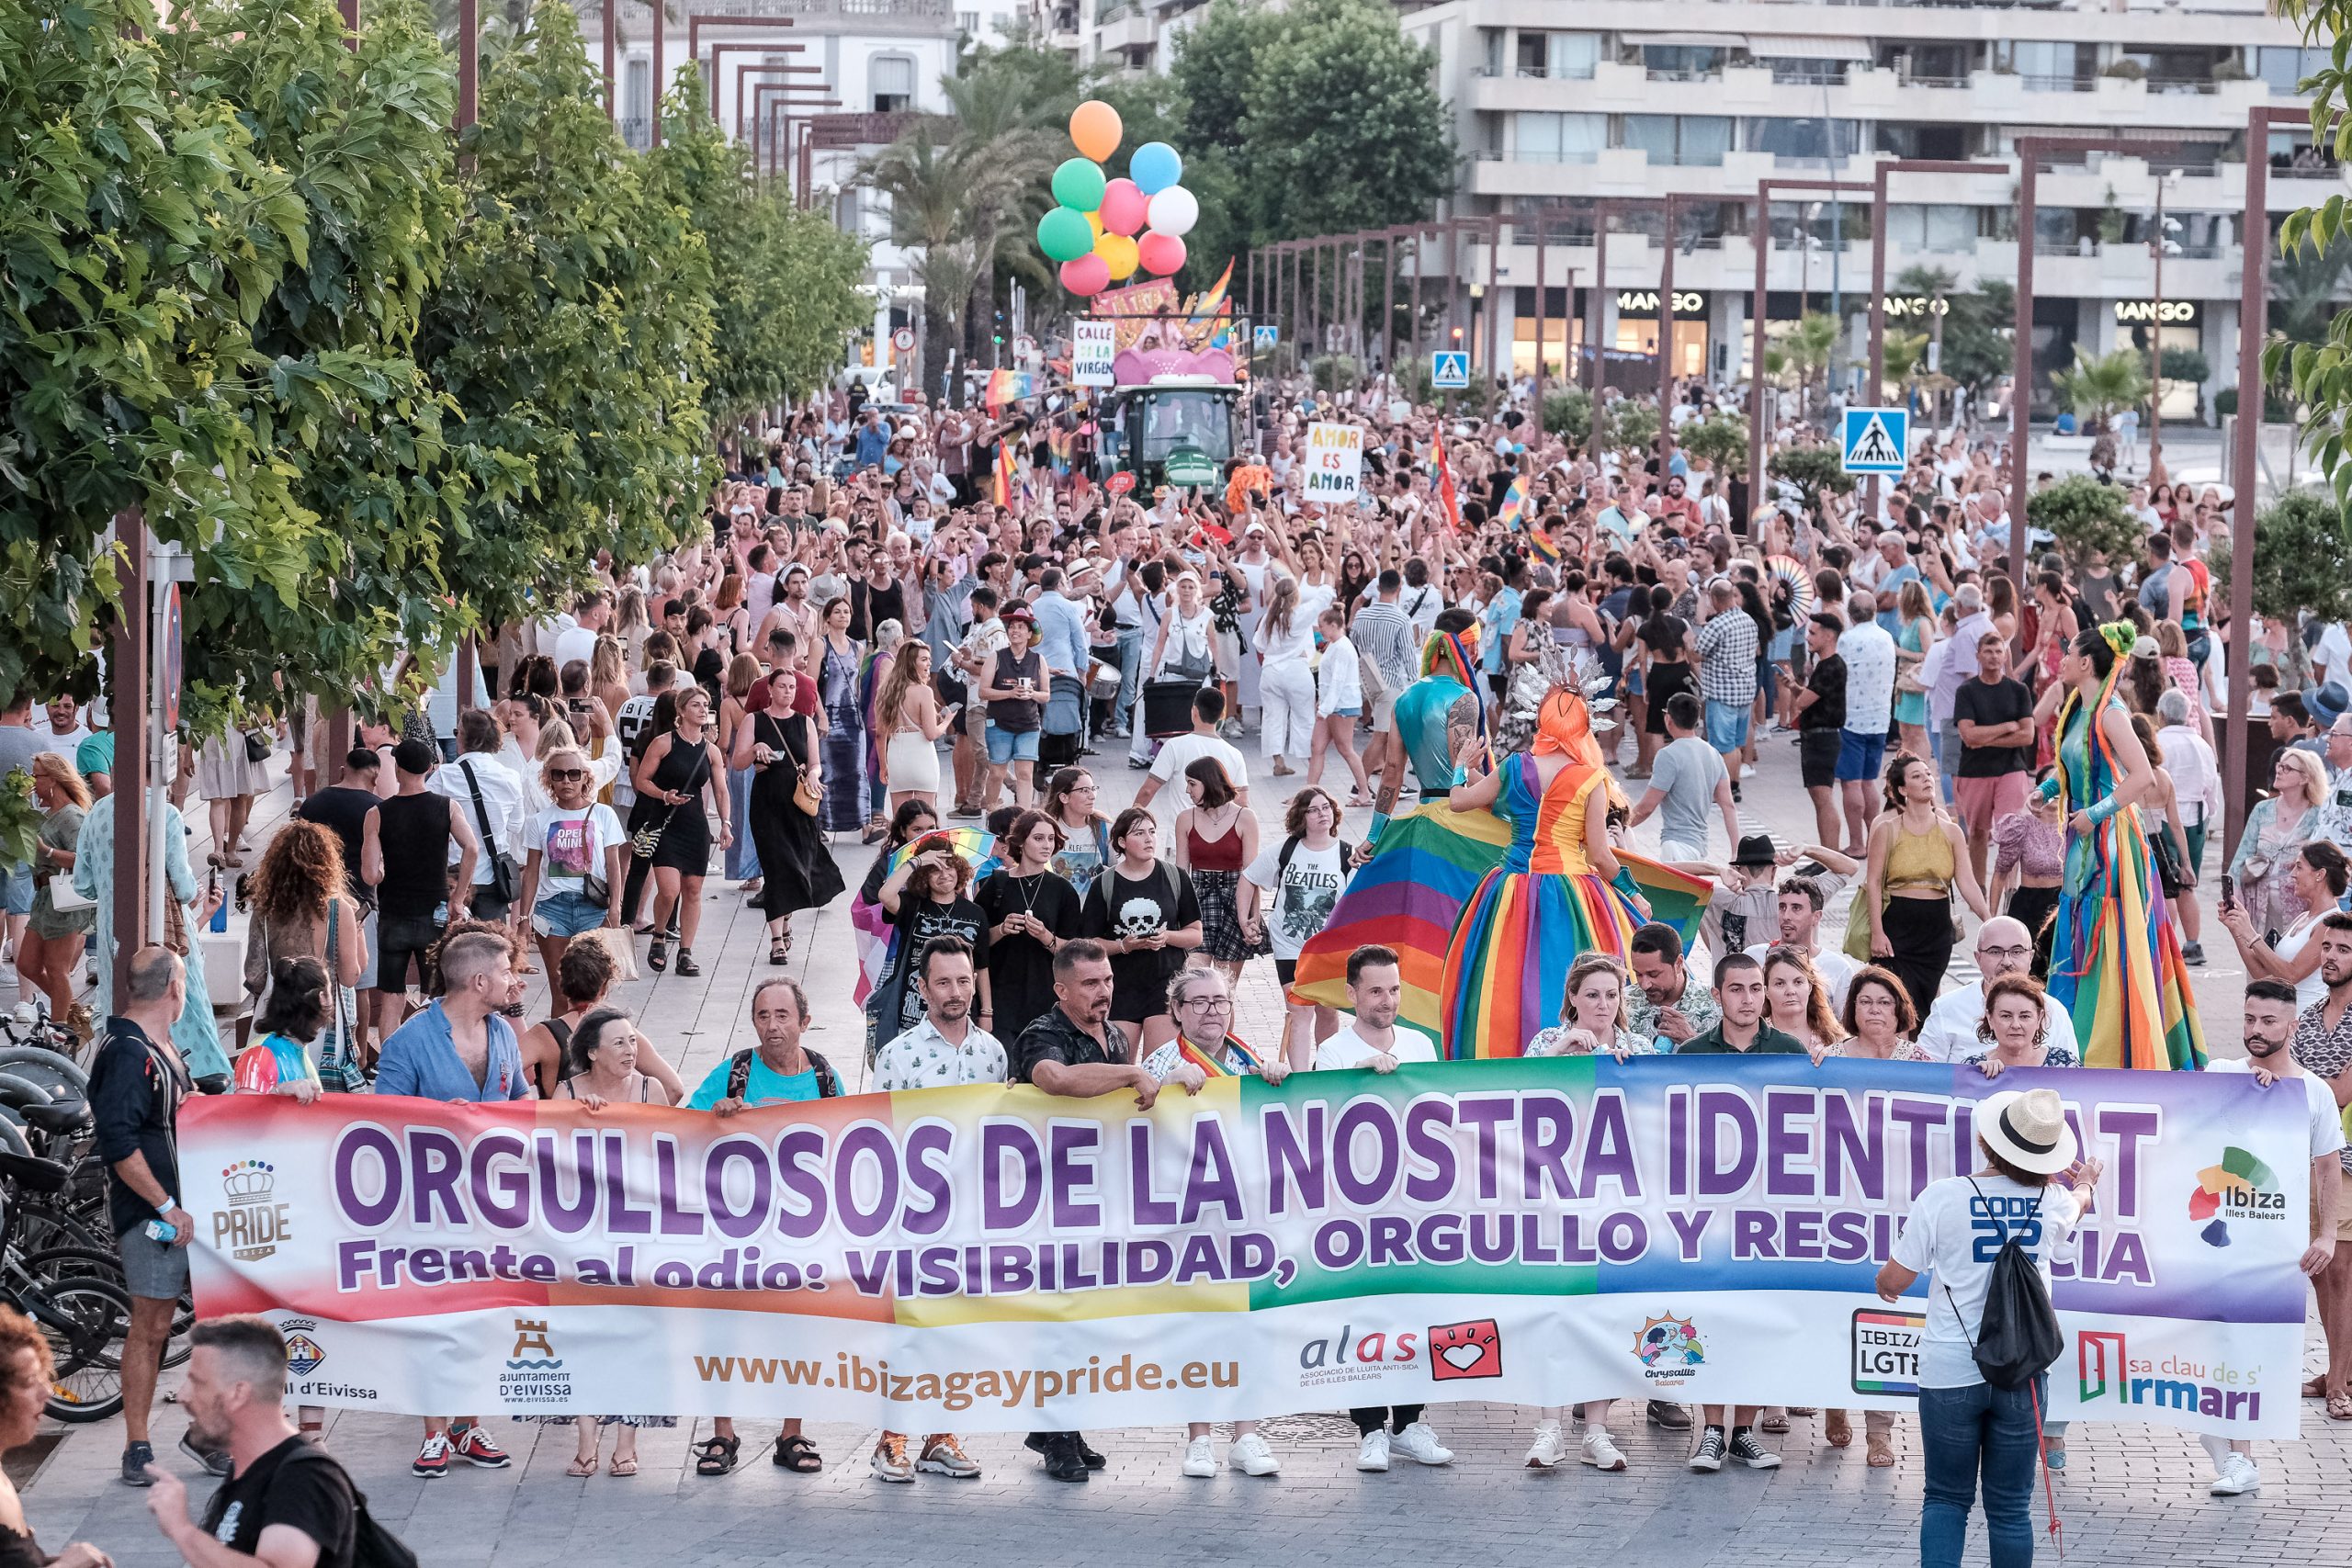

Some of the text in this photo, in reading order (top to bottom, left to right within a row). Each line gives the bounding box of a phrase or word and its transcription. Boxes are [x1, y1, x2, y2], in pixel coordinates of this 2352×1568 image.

[1617, 292, 1703, 312] MANGO
[1867, 297, 1950, 316] ANGO
[1077, 327, 1113, 341] CALLE
[1095, 344, 1111, 358] LA
[1075, 362, 1114, 375] VIRGEN
[1311, 426, 1359, 449] AMOR
[1322, 453, 1341, 469] ES
[1308, 471, 1354, 491] AMOR
[621, 703, 655, 716] IBIZ
[1284, 863, 1339, 890] BEATLES
[334, 1092, 2158, 1238] ORGULLOSOS DE LA NOSTRA IDENTIT
[1969, 1196, 2043, 1218] CODE
[2226, 1185, 2286, 1209] Ibiza
[2225, 1209, 2286, 1220] Illes Balears
[212, 1203, 292, 1249] PRIDE
[1971, 1219, 2043, 1263] 22
[236, 1247, 272, 1258] IBIZA
[339, 1238, 558, 1290] Frente
[575, 1246, 635, 1287] al
[651, 1246, 824, 1291] odio:
[843, 1233, 1295, 1296] VISIBILIDAD,
[1314, 1211, 1650, 1269] ORGULLO
[1669, 1210, 1711, 1258] Y
[1300, 1325, 1419, 1370] alas
[1300, 1366, 1344, 1380] ASSOCIACIÓ
[1356, 1365, 1381, 1373] LLUITA
[1382, 1363, 1419, 1371] ANTI-SIDA
[1326, 1376, 1346, 1384] ILLES
[1348, 1372, 1382, 1382] BALEARS
[1645, 1368, 1696, 1379] Chrysallis
[2129, 1359, 2153, 1373] sa
[2161, 1355, 2205, 1379] clau
[2212, 1362, 2238, 1385] de
[300, 1382, 378, 1400] d'Eivissa
[694, 1351, 1239, 1412] www.ibizagaypride.eu
